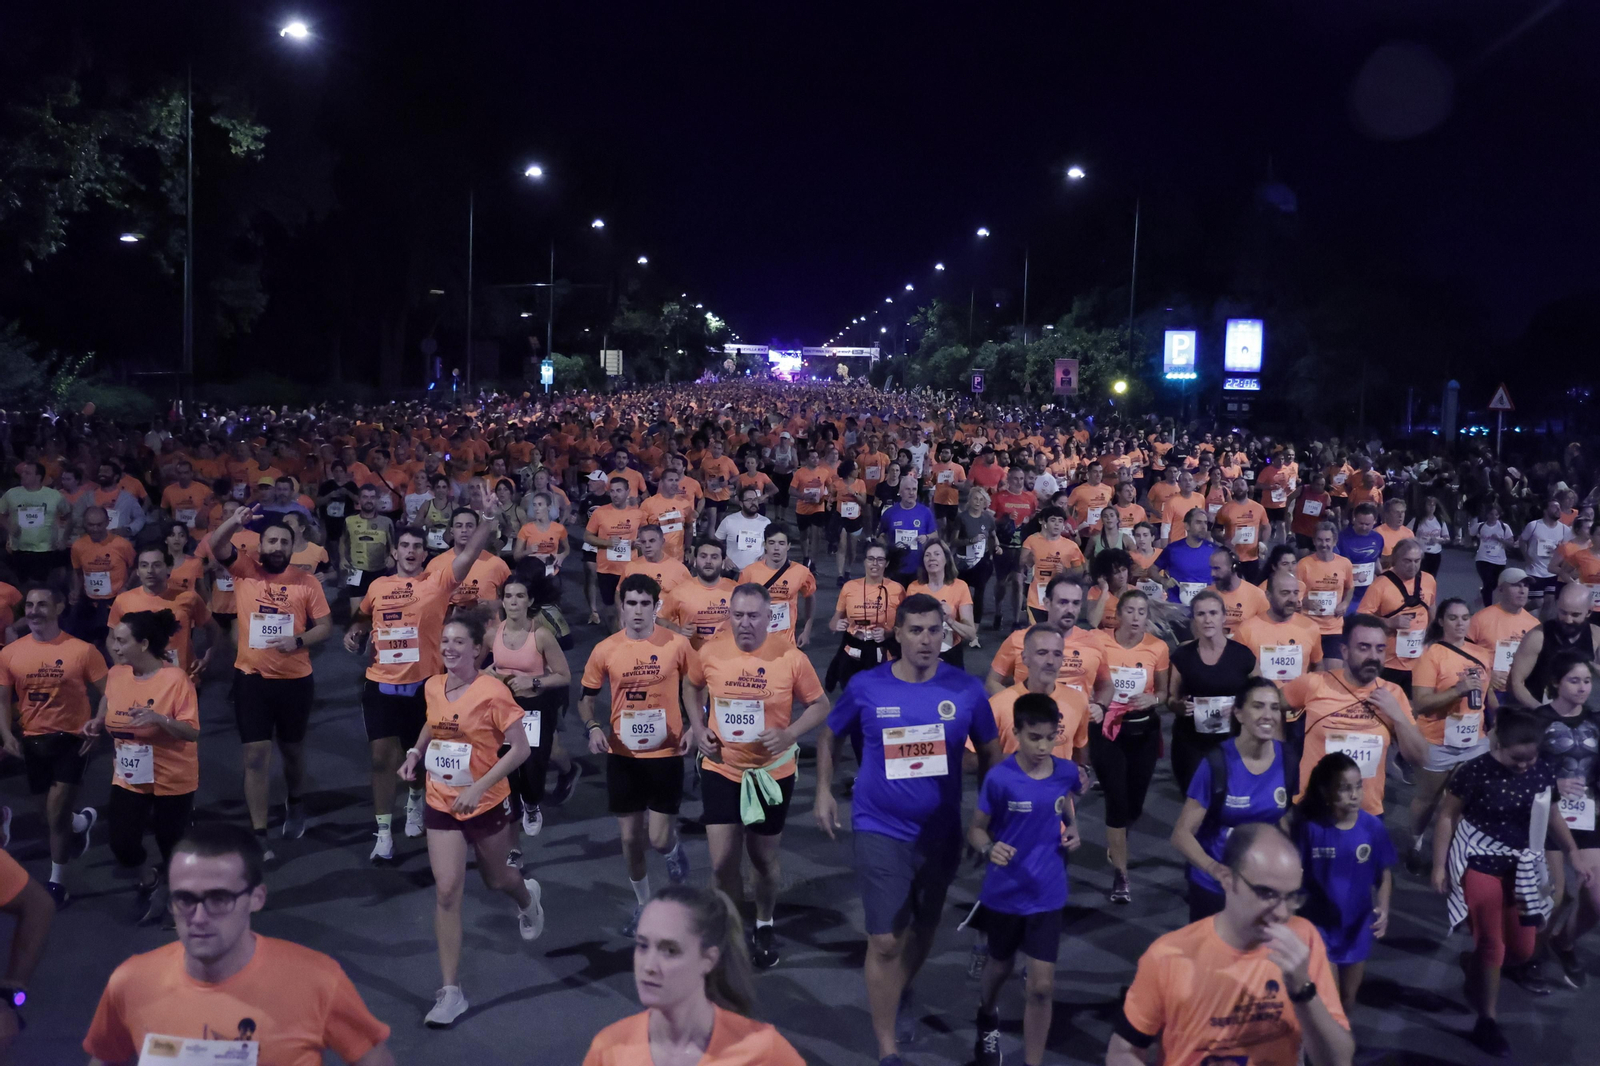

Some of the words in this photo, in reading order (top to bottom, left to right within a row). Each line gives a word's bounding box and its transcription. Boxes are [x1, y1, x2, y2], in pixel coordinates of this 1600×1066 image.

[1226, 378, 1258, 388] 22:06
[262, 625, 282, 634] 8591
[388, 640, 408, 649] 1378
[1270, 657, 1295, 666] 14820
[1114, 678, 1136, 689] 8859
[725, 713, 755, 725] 20858
[632, 724, 655, 734] 6925
[899, 742, 934, 757] 17382
[435, 756, 460, 769] 13611
[1561, 799, 1585, 811] 3549
